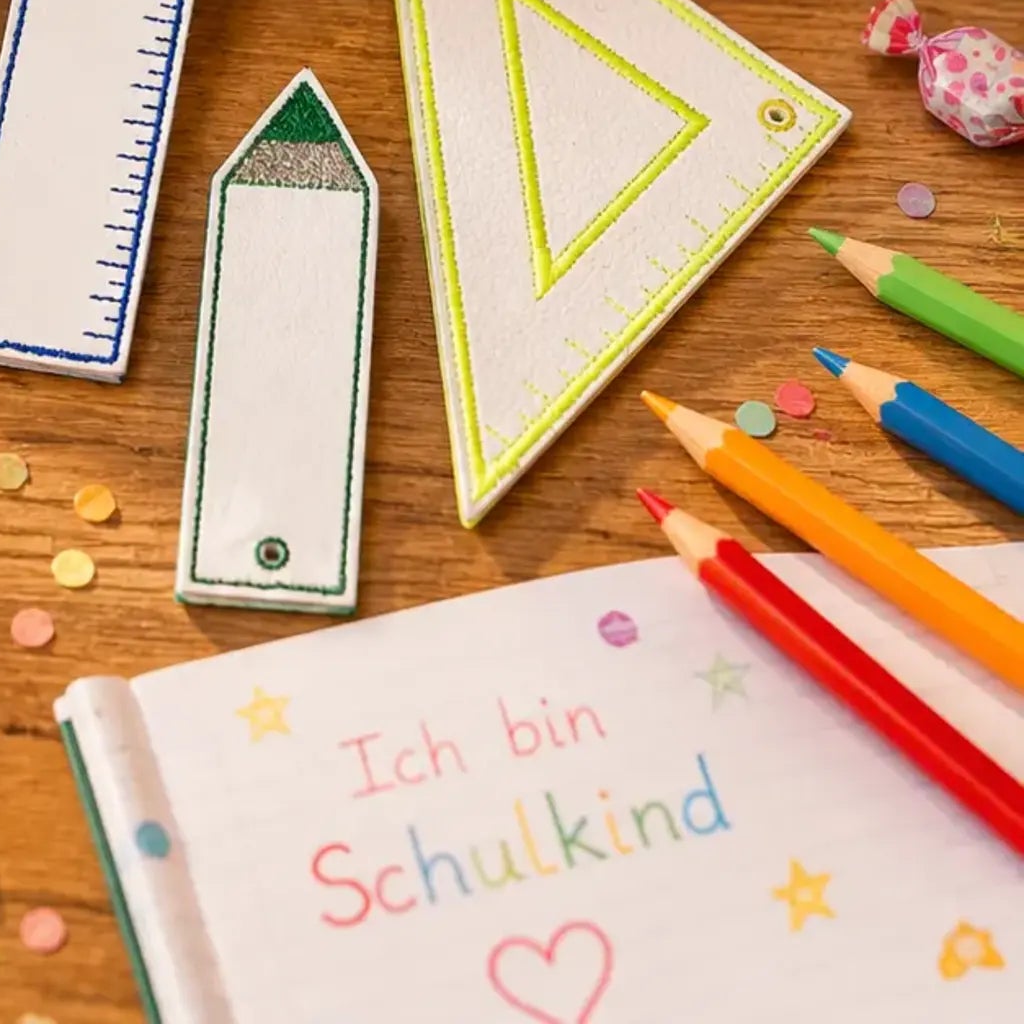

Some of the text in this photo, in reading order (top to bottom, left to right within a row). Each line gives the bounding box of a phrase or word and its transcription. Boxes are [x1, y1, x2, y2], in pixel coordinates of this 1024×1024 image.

[338, 697, 607, 799] Ich bin
[311, 752, 731, 928] Schulkind
